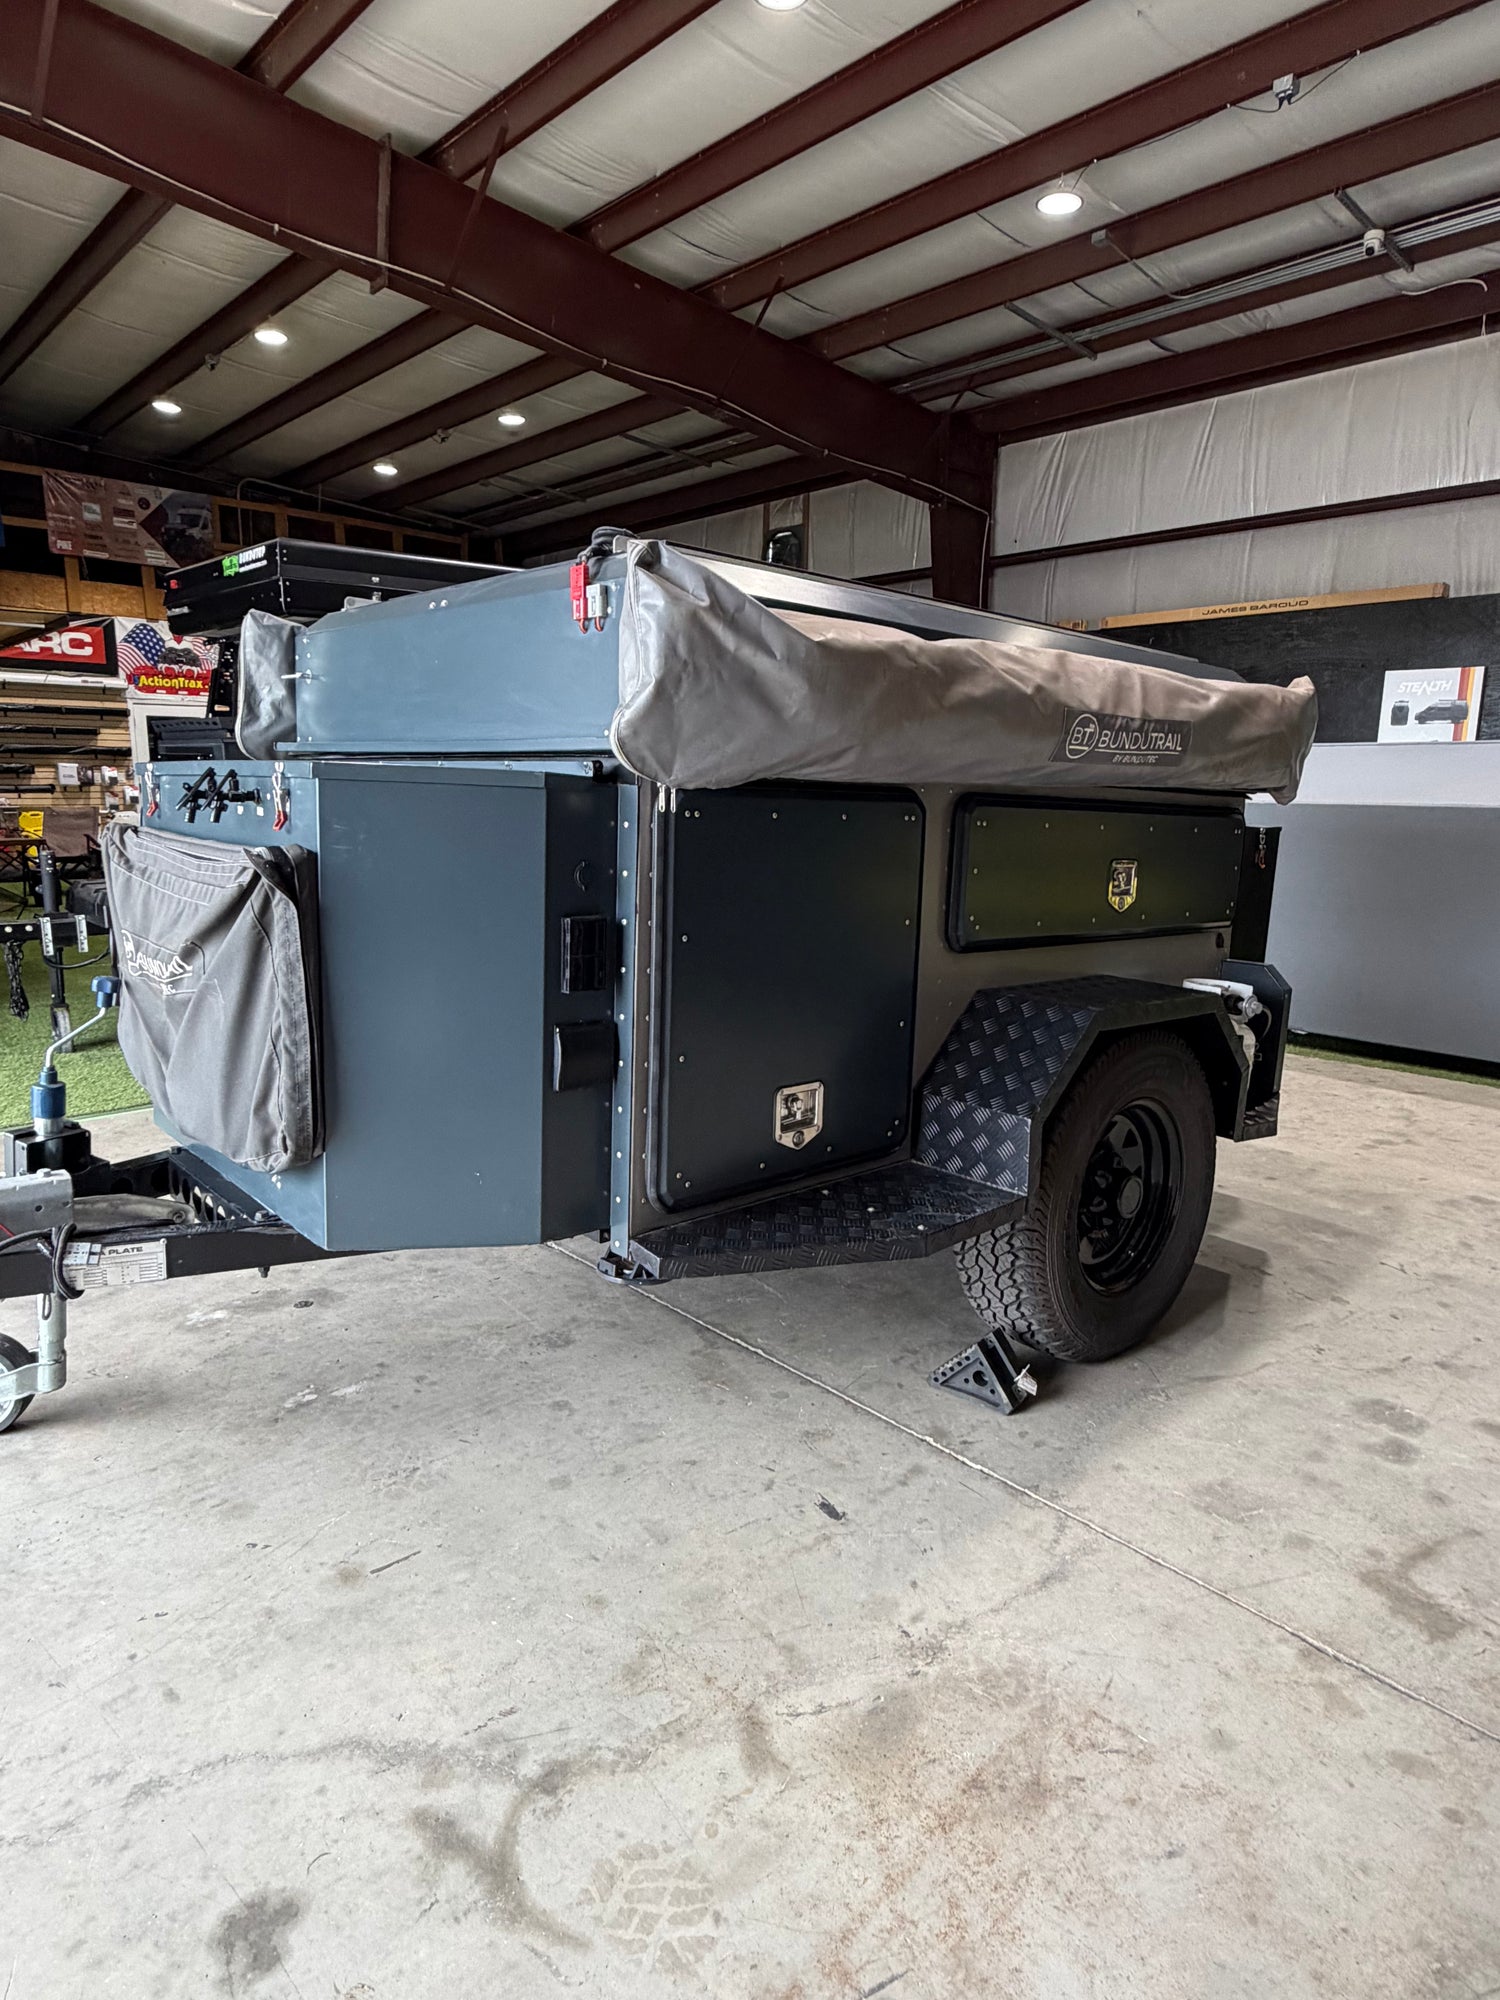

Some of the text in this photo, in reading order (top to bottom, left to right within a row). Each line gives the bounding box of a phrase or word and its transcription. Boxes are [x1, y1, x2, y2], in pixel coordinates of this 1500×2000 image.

[1201, 599, 1309, 615] JAMES BAROUD
[1397, 680, 1453, 696] STEALTH
[1098, 729, 1182, 751] BUNDUTRAIL
[108, 1246, 143, 1256] PLATE
